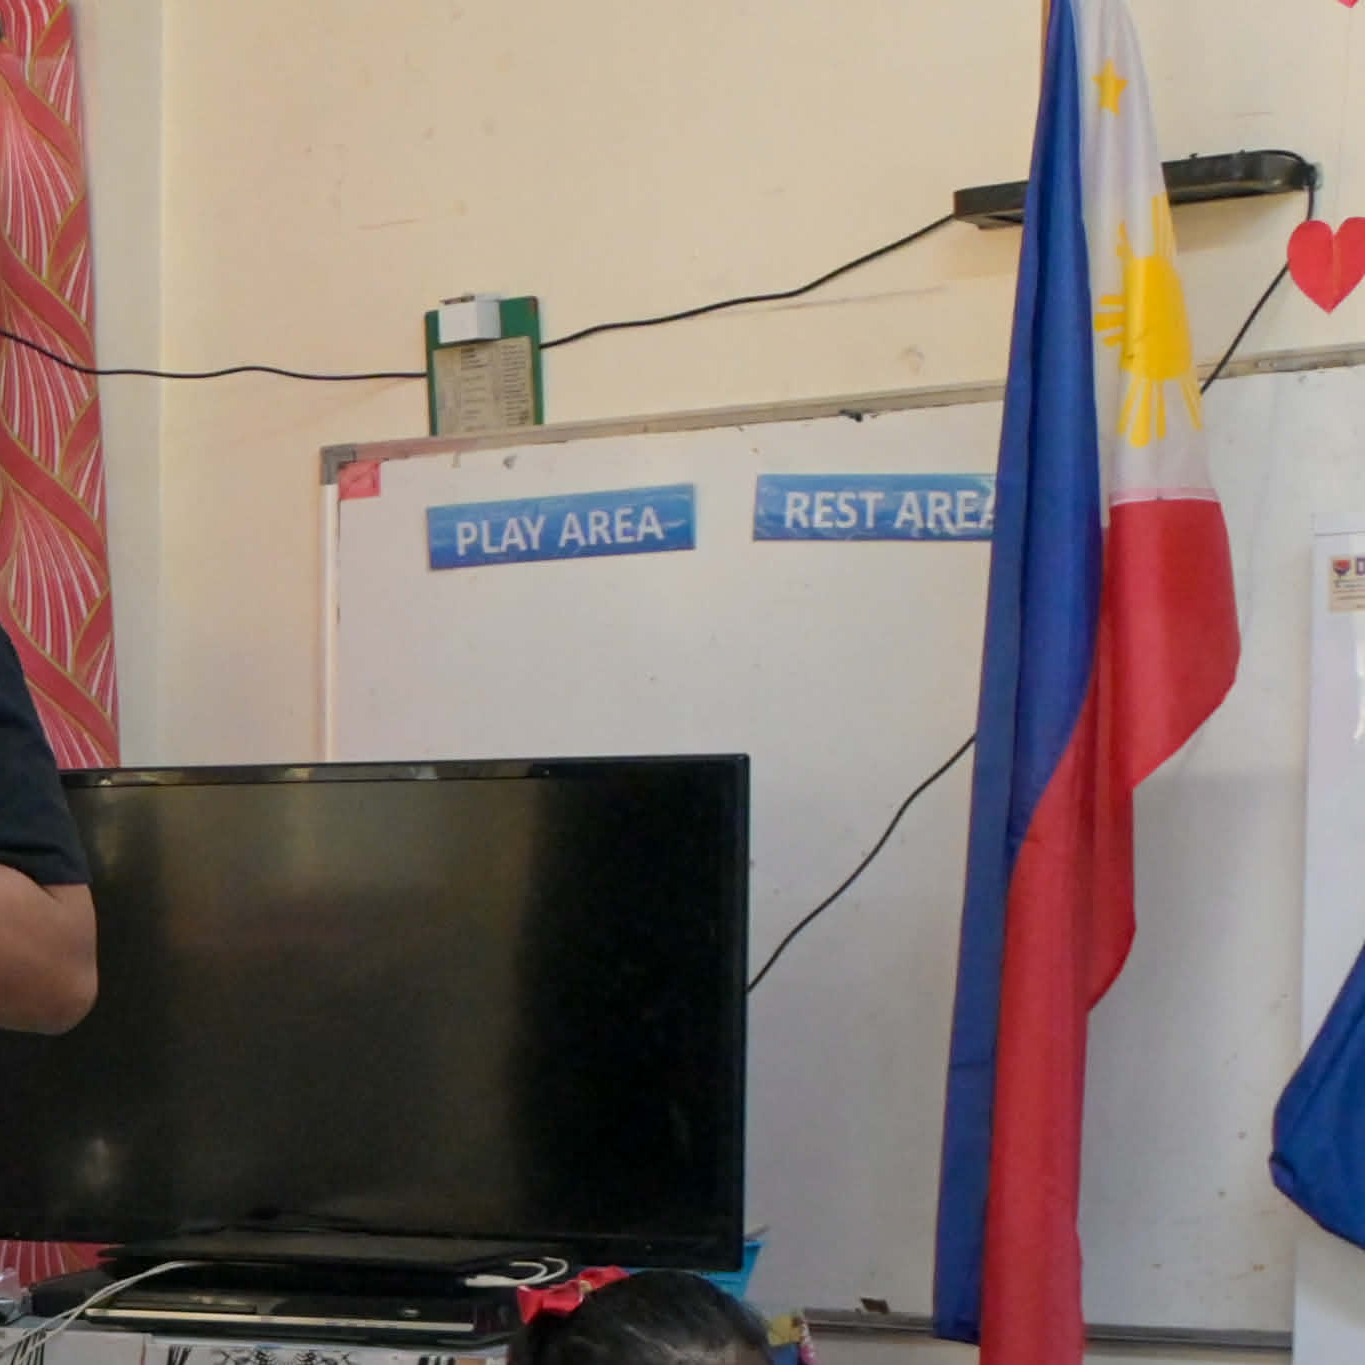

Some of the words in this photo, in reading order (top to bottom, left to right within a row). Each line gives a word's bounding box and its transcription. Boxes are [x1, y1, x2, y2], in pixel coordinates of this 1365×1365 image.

[456, 515, 546, 556] PLAY
[558, 506, 665, 548] AREA
[784, 490, 885, 530] REST
